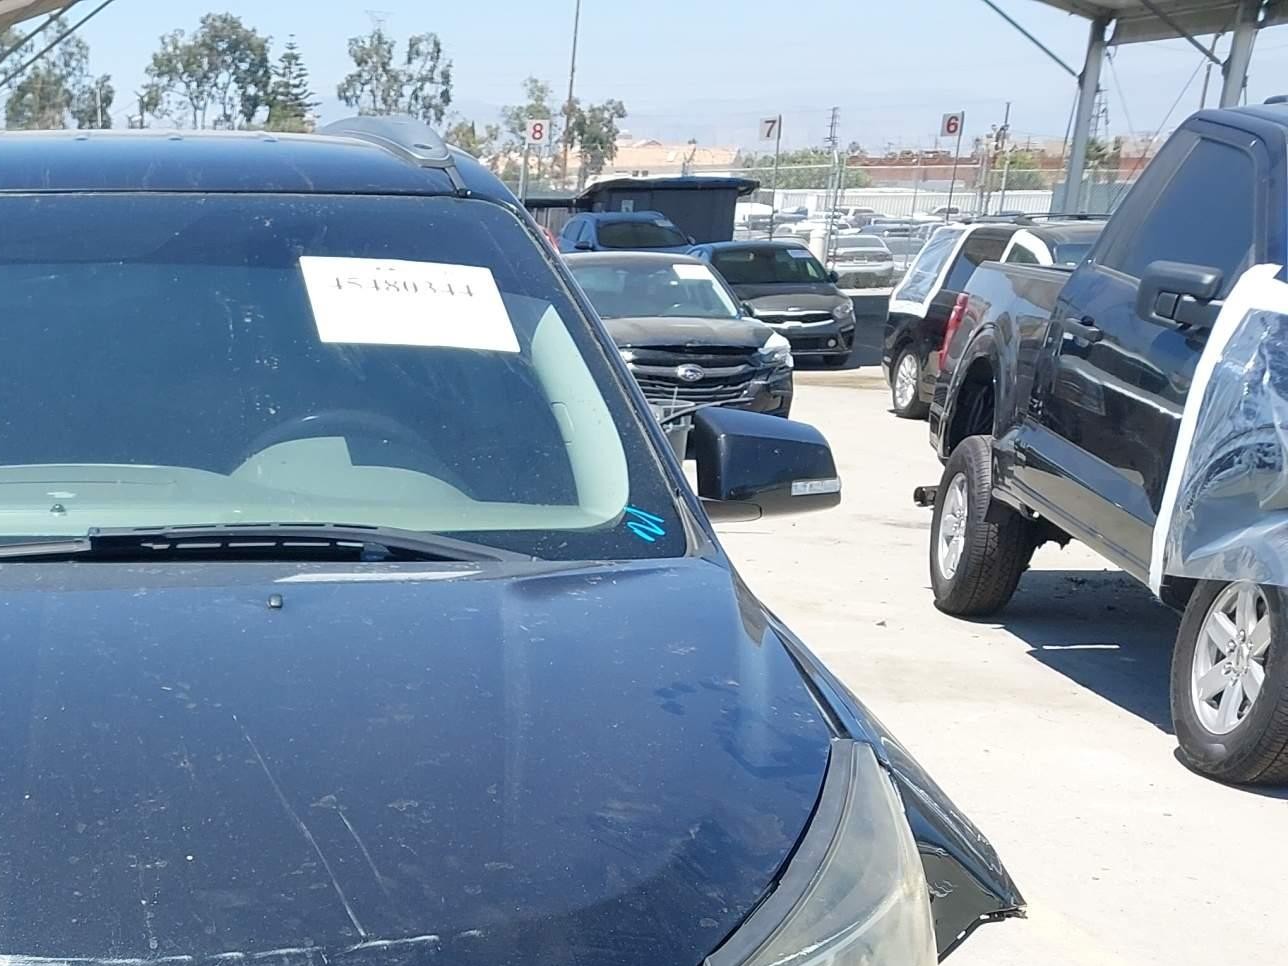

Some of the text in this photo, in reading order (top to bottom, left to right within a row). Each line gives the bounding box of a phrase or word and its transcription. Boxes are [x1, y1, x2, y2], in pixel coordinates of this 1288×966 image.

[532, 122, 543, 140] 8
[764, 119, 777, 138] 7
[946, 115, 959, 134] 6
